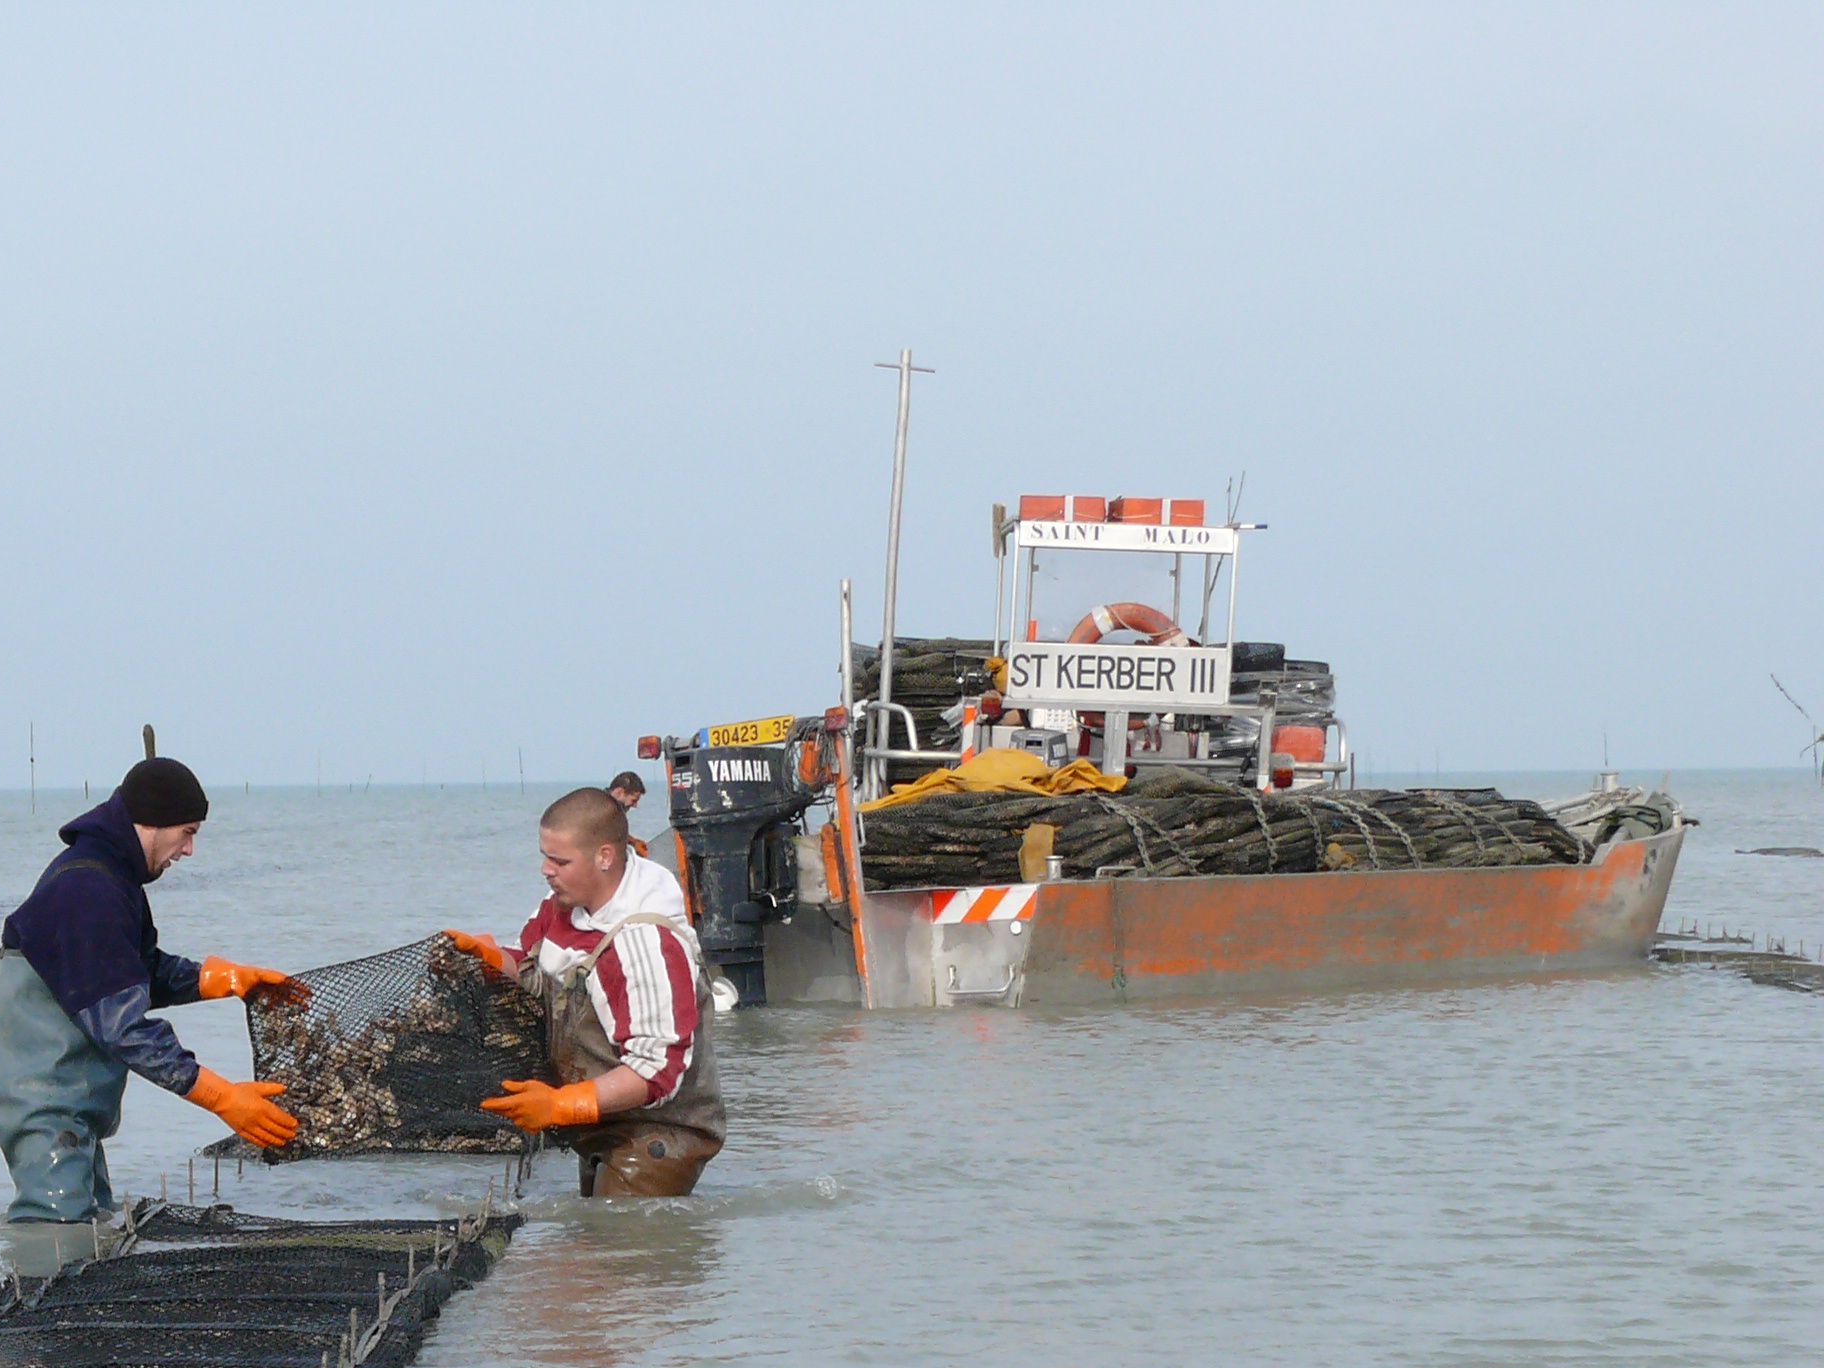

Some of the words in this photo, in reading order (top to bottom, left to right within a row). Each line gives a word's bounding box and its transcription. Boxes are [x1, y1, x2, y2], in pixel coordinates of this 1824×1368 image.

[1031, 523, 1105, 542] SAINT
[1142, 527, 1211, 545] MALO
[1010, 653, 1048, 689] ST
[1056, 654, 1177, 692] KERBER
[1190, 658, 1216, 693] III
[711, 724, 759, 747] 30423
[707, 759, 772, 782] YAMAHA
